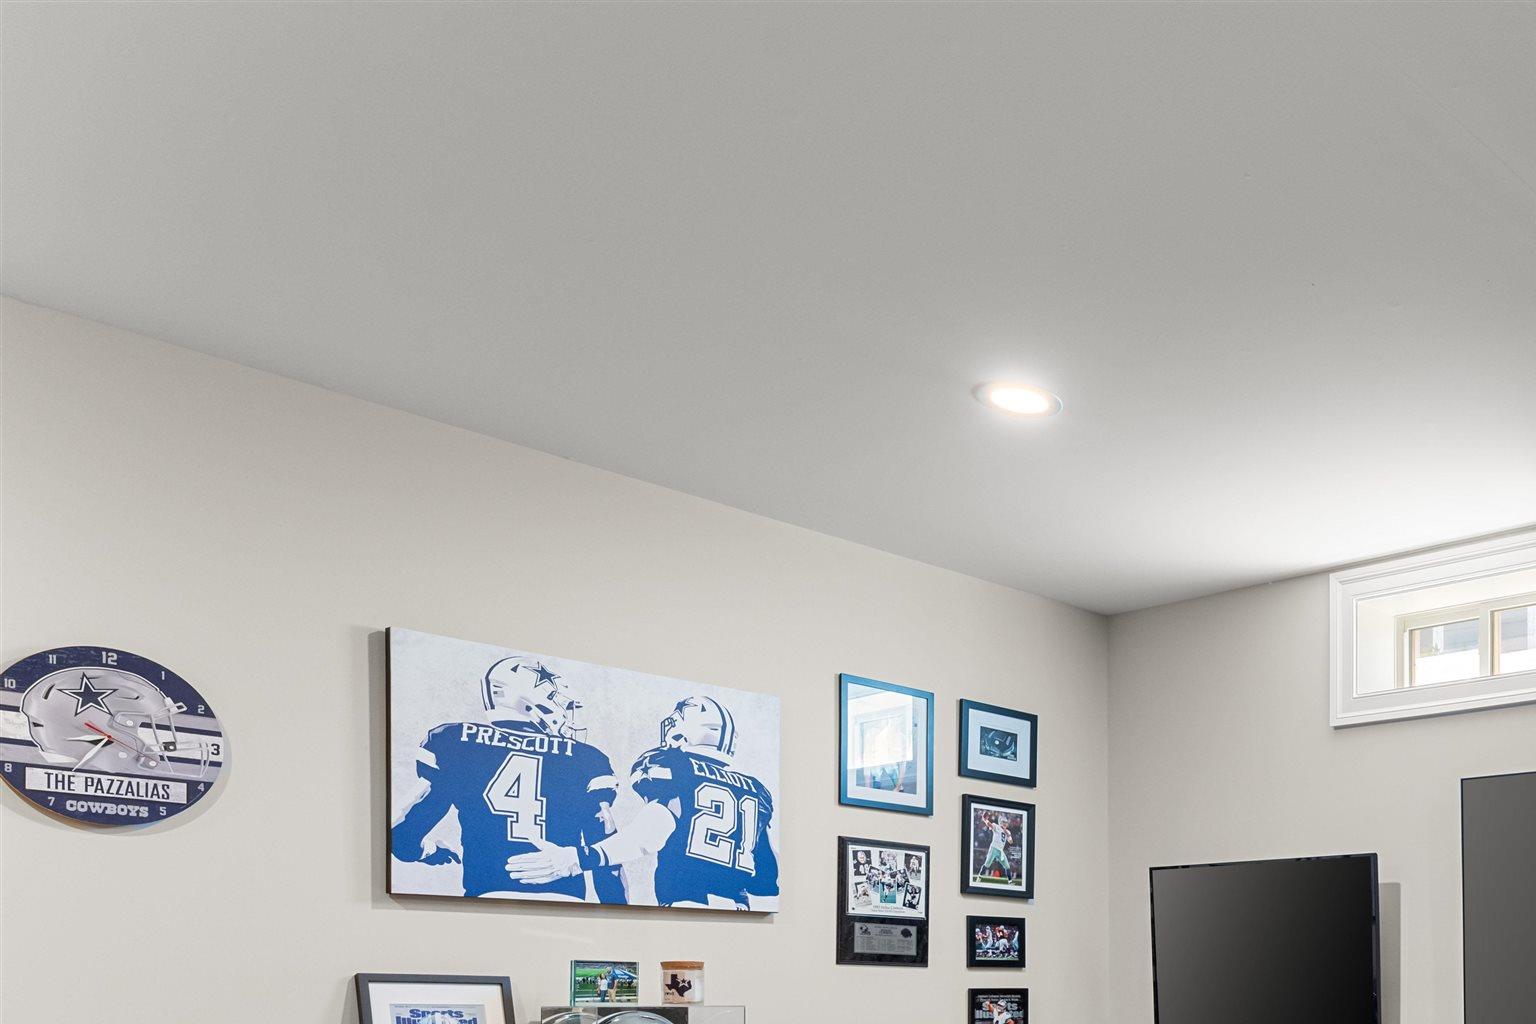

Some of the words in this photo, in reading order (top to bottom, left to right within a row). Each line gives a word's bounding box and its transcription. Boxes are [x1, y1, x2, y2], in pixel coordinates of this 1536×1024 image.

[48, 654, 57, 664] 11
[102, 651, 118, 665] 12
[161, 671, 166, 680] 1
[4, 678, 16, 688] 10
[197, 704, 205, 714] 2
[460, 722, 577, 757] PRESCOTT
[211, 743, 220, 756] 3
[4, 763, 12, 772] 8
[689, 756, 759, 794] ELLIOTT
[44, 772, 79, 791] THE
[84, 776, 170, 800] PAZZALIAS
[197, 782, 206, 792] 4
[48, 797, 55, 806] 7
[483, 751, 547, 846] 4
[66, 799, 149, 818] COWBOYS
[160, 806, 167, 816] 5
[685, 781, 760, 877] 21
